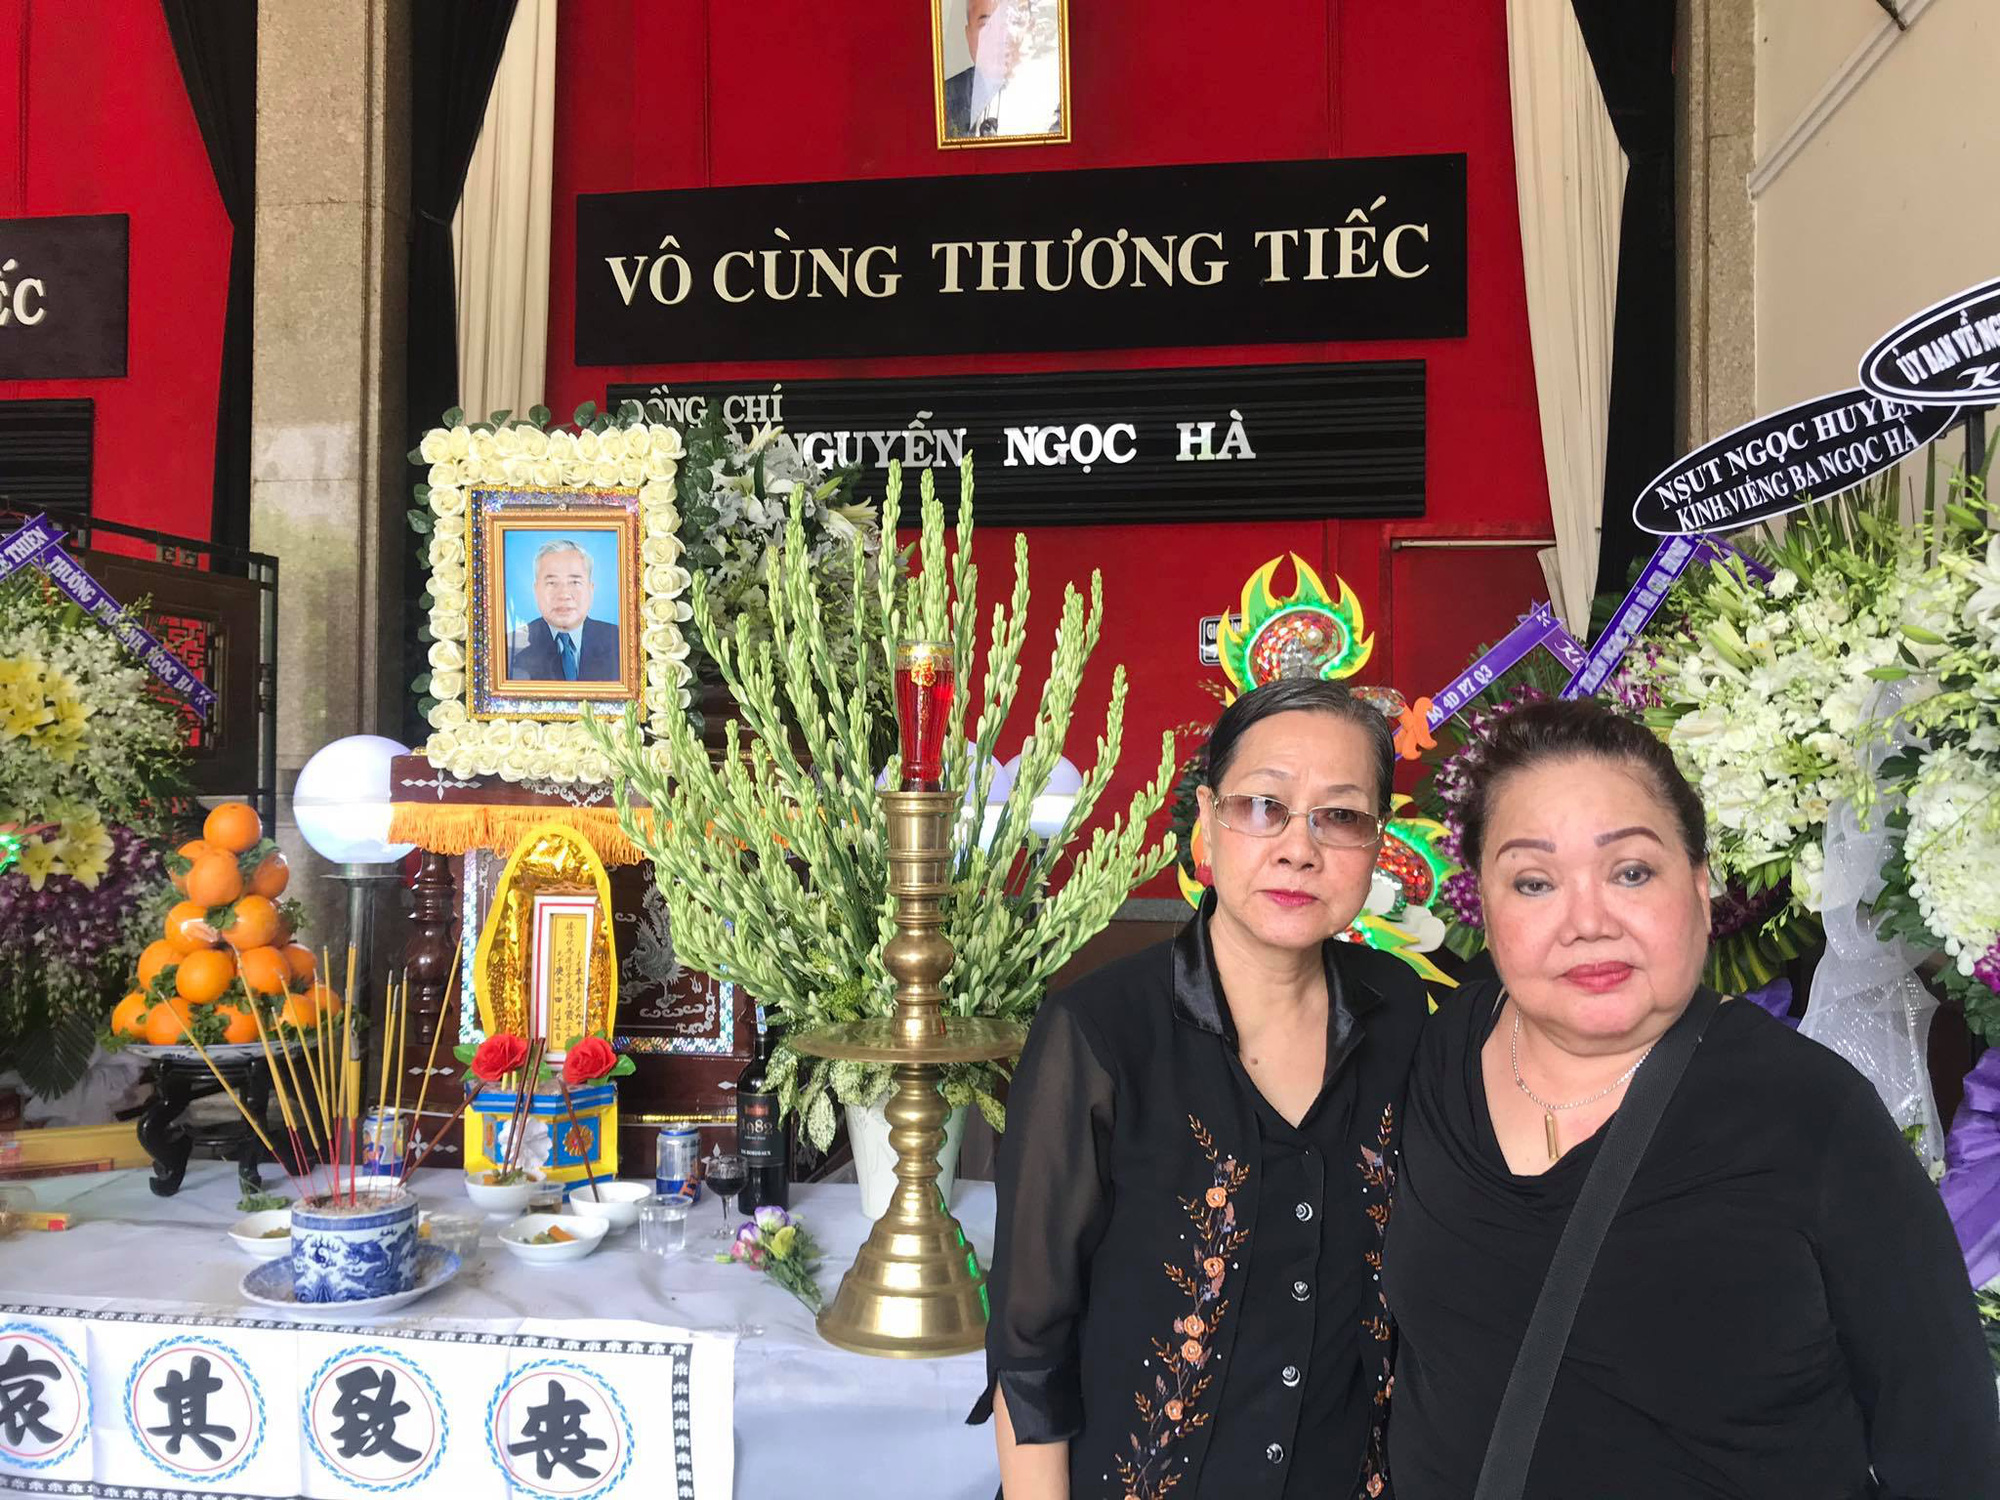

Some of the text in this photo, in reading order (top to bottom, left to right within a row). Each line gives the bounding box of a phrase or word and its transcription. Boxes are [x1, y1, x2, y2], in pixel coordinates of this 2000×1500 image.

[605, 195, 1430, 306] VÔ CÙNG THƯƠNG TIẾC
[1918, 334, 1961, 375] BAN
[723, 384, 783, 423] CHÍ
[776, 410, 1257, 474] NGUYỄN NGỌC HÀ
[1655, 457, 1724, 510] NSUT
[1724, 423, 1809, 476] NGỌC
[1676, 417, 1920, 532] KÍNH VIẾNG BA NGỌC HÀ
[1474, 664, 1494, 686] Q3
[147, 1355, 237, 1459] 其
[331, 1366, 422, 1462] 致
